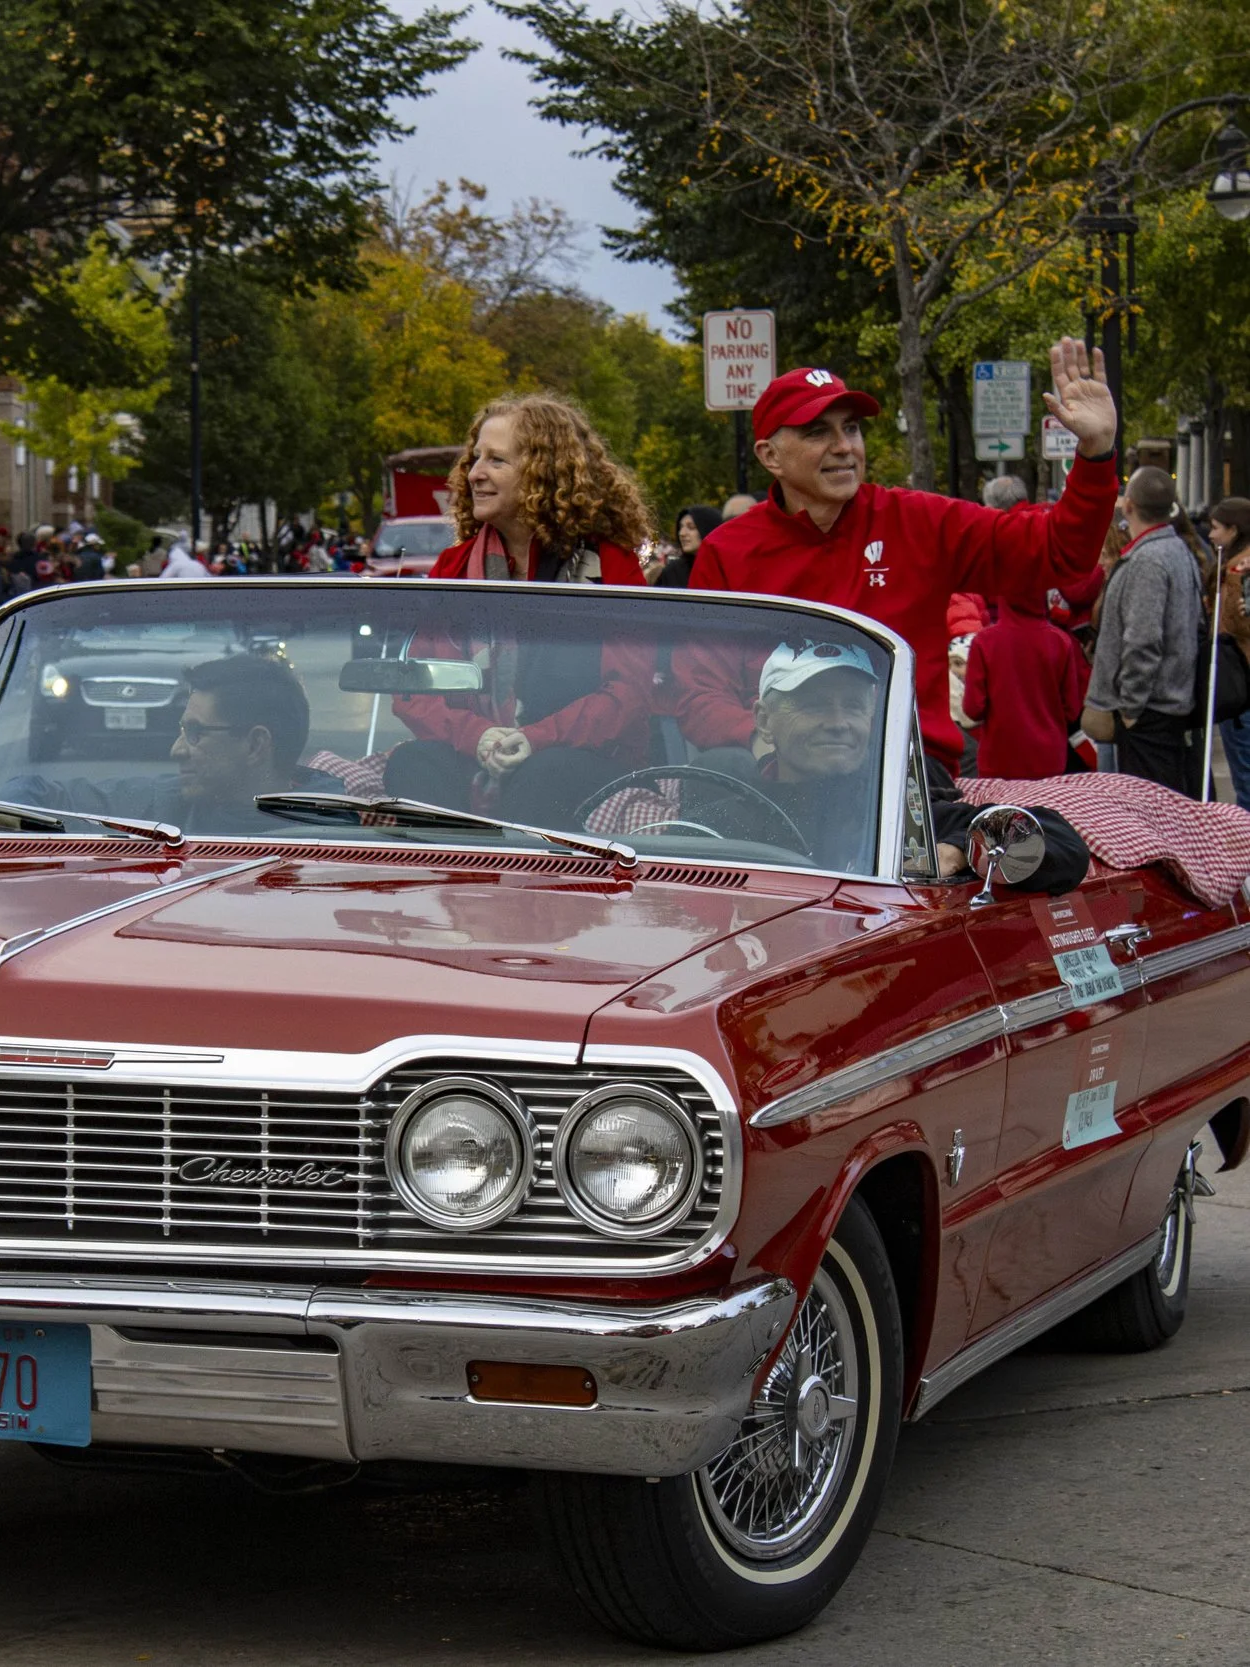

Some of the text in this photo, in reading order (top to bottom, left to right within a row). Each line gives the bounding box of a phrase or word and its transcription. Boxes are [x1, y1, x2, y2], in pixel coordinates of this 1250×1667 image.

[725, 319, 752, 339] NO
[710, 343, 769, 360] PARKING
[726, 363, 754, 379] ANY
[805, 368, 833, 388] W
[725, 383, 756, 399] TIME
[864, 540, 883, 564] W
[179, 1156, 345, 1187] Chevrolet
